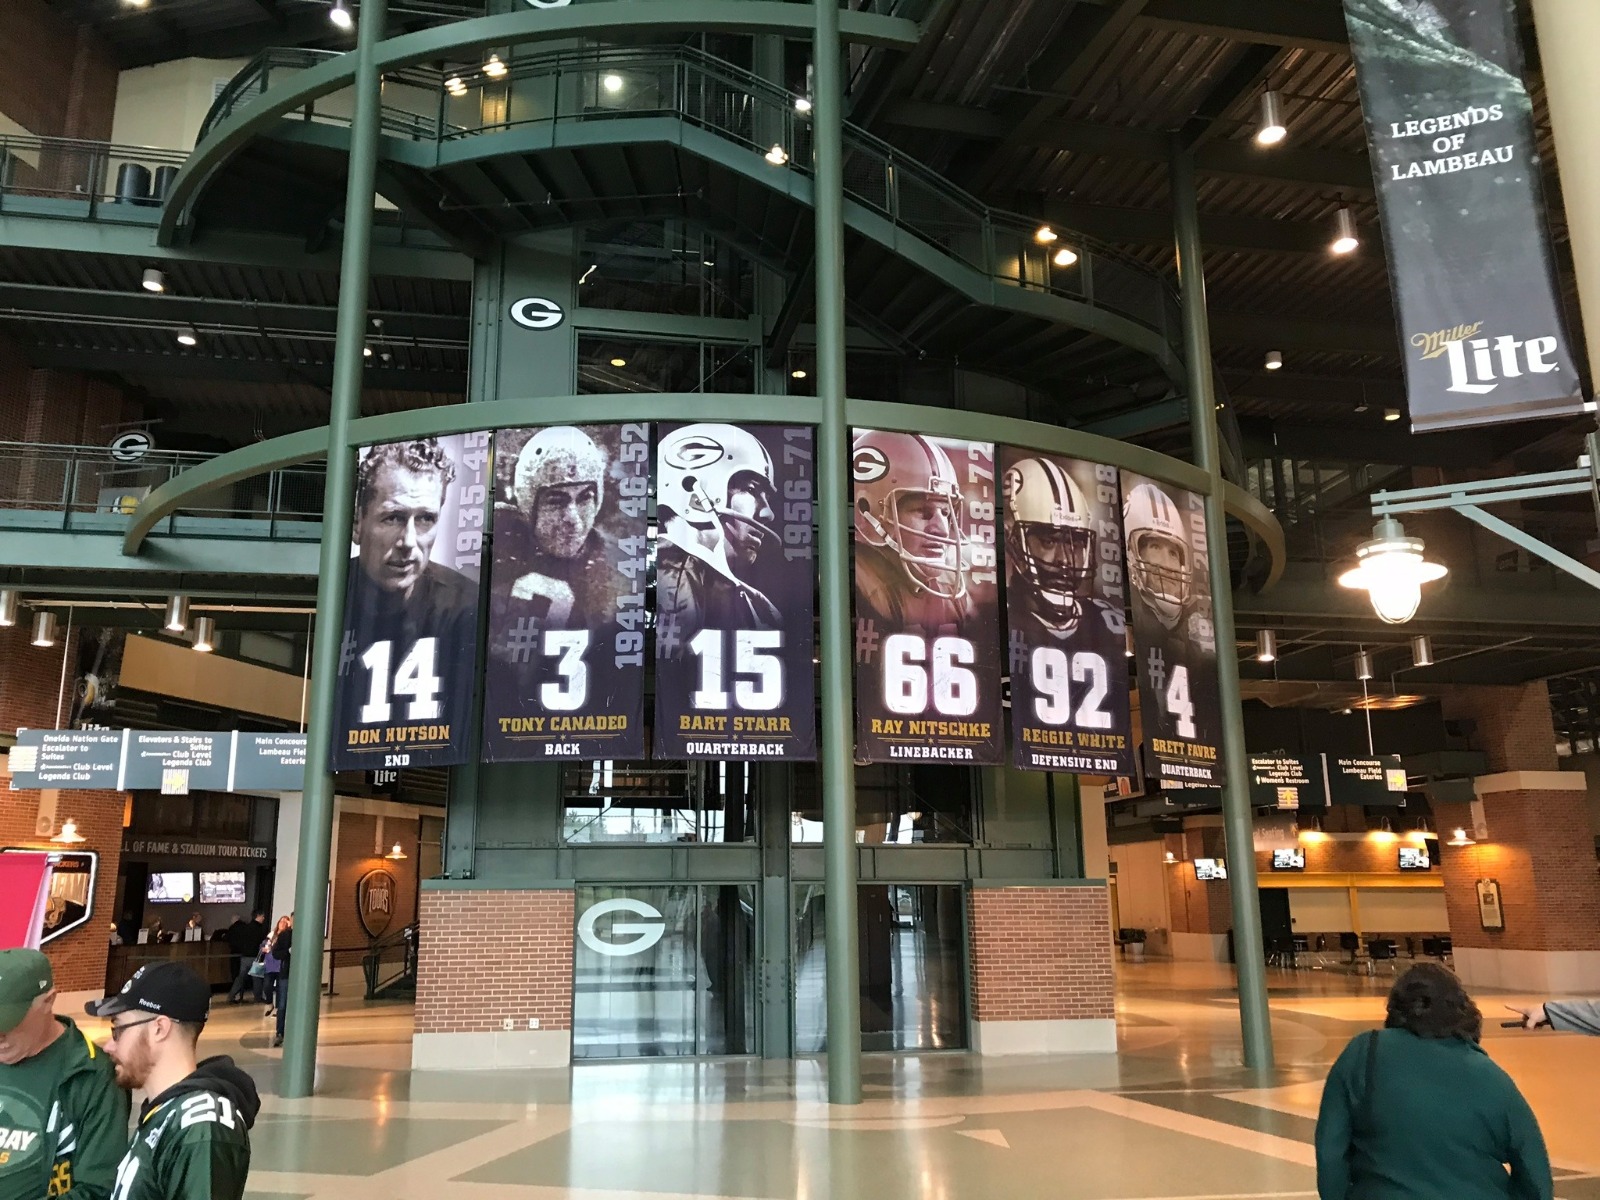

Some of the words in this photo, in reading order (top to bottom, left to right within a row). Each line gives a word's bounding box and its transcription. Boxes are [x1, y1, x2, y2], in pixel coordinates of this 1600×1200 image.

[1390, 104, 1504, 139] LEGENDS
[1432, 134, 1466, 154] OF
[1391, 145, 1515, 180] LAMBEAU
[1410, 320, 1485, 361] Miller
[1445, 334, 1558, 395] Lite
[619, 423, 649, 518] 46-52
[454, 431, 489, 570] 1935-45
[783, 427, 812, 562] 1956-71
[967, 442, 998, 585] 1958-72
[1095, 463, 1124, 600] 1993-98
[614, 534, 647, 670] 1941-44
[541, 629, 589, 711] 3
[690, 629, 785, 711] 15
[885, 634, 978, 716] 66
[362, 636, 441, 723] 14
[1032, 646, 1112, 729] 92
[1166, 664, 1196, 739] 4
[499, 717, 546, 732] TONY
[550, 715, 628, 731] CANADEO
[679, 715, 727, 731] BART
[734, 716, 792, 732] STARR
[871, 719, 906, 735] RAY
[908, 720, 991, 738] NITSCHKE
[43, 734, 70, 743] Oneida
[72, 734, 98, 743] Nation
[100, 735, 118, 743] Gate
[138, 735, 173, 744] Elevators
[173, 736, 180, 744] &
[181, 736, 203, 744] Stairs
[255, 737, 273, 745] Main
[274, 737, 307, 746] Concours
[348, 729, 380, 745] DON
[385, 725, 450, 742] HUTSON
[1023, 727, 1074, 746] REGGIE
[1077, 734, 1125, 749] WHITE
[42, 744, 79, 752] Escalator
[172, 750, 190, 758] Club
[191, 750, 212, 759] Level
[189, 743, 212, 751] Suites
[258, 748, 291, 756] Lambeau
[292, 748, 307, 756] Fiel
[545, 743, 580, 755] BACK
[686, 742, 784, 756] QUARTERBACK
[890, 746, 974, 760] LINEBACKER
[1152, 738, 1185, 757] BRETT
[1187, 742, 1217, 760] FAVRE
[41, 752, 65, 760] Suites
[162, 758, 193, 767] Legends
[194, 758, 212, 767] Club
[280, 757, 306, 765] Eaterie
[385, 754, 410, 767] END
[1031, 753, 1093, 769] DEFENSIVE
[1095, 759, 1118, 771] END
[1338, 758, 1352, 766] Main
[73, 763, 91, 771] Club
[92, 763, 113, 771] Level
[1161, 763, 1212, 780] QUARTERBACK
[38, 772, 71, 781] Legends
[72, 772, 91, 780] Club
[373, 769, 397, 786] Lite
[133, 841, 145, 853] OF
[146, 841, 170, 854] FAME
[171, 842, 179, 854] &
[180, 843, 216, 856] STADIUM
[217, 845, 238, 857] TOUR
[239, 846, 268, 858] TICKETS
[138, 998, 162, 1011] Reebok
[181, 1092, 236, 1130] 21
